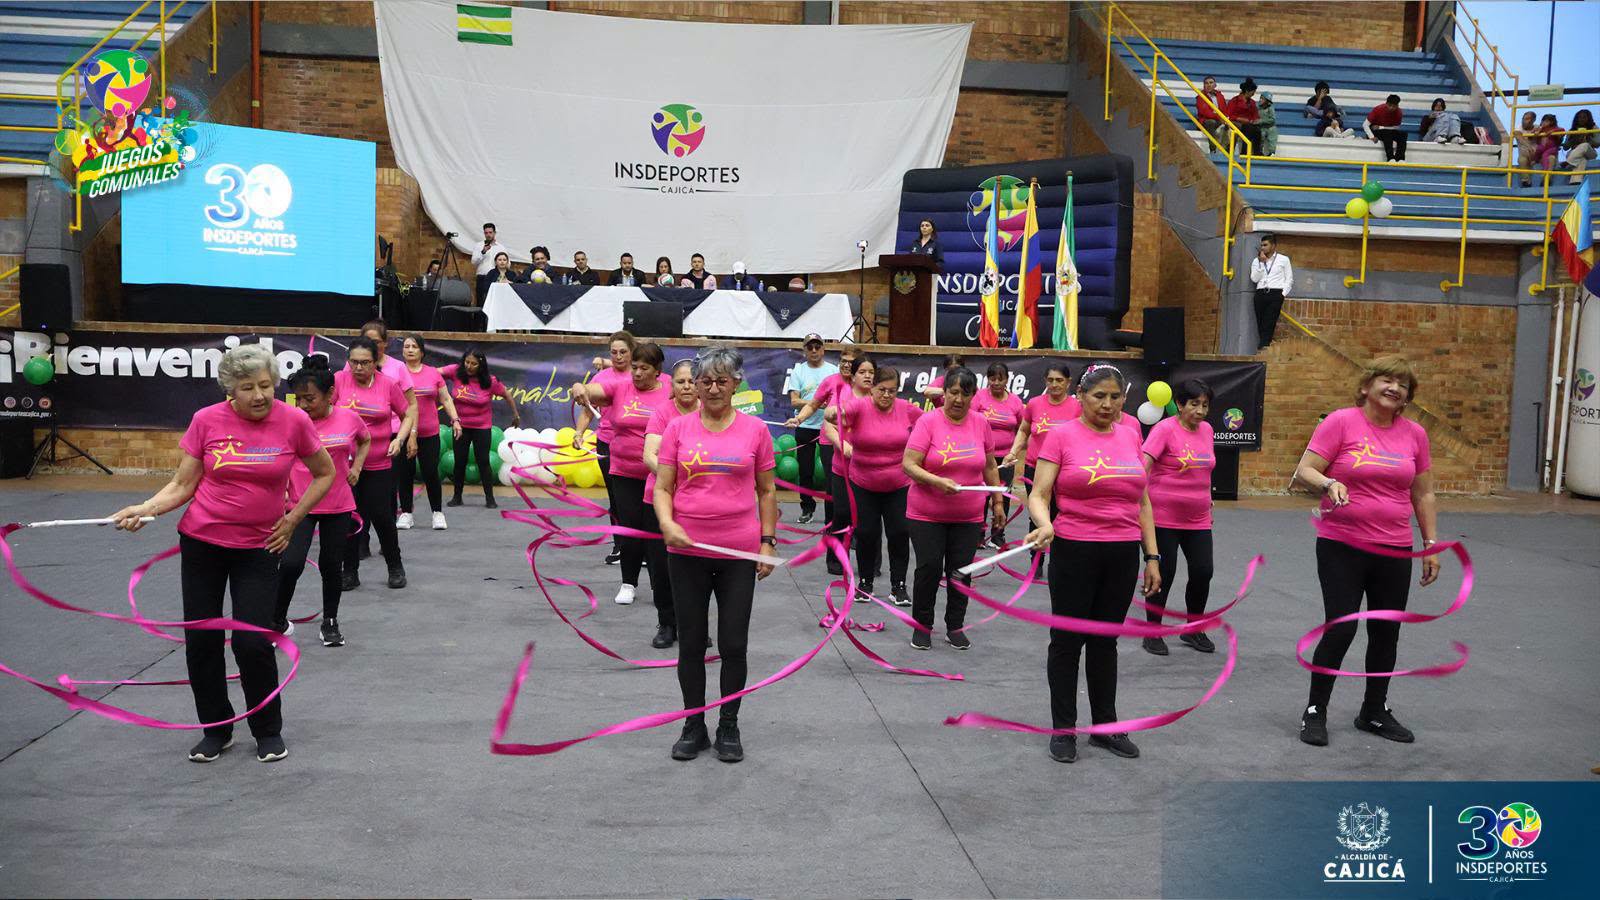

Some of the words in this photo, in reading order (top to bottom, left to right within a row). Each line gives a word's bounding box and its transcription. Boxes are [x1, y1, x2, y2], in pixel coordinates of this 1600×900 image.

[614, 162, 740, 183] INSDEPORTES
[203, 228, 297, 249] INSDEPORTES
[1213, 432, 1256, 440] NSDEPORTES
